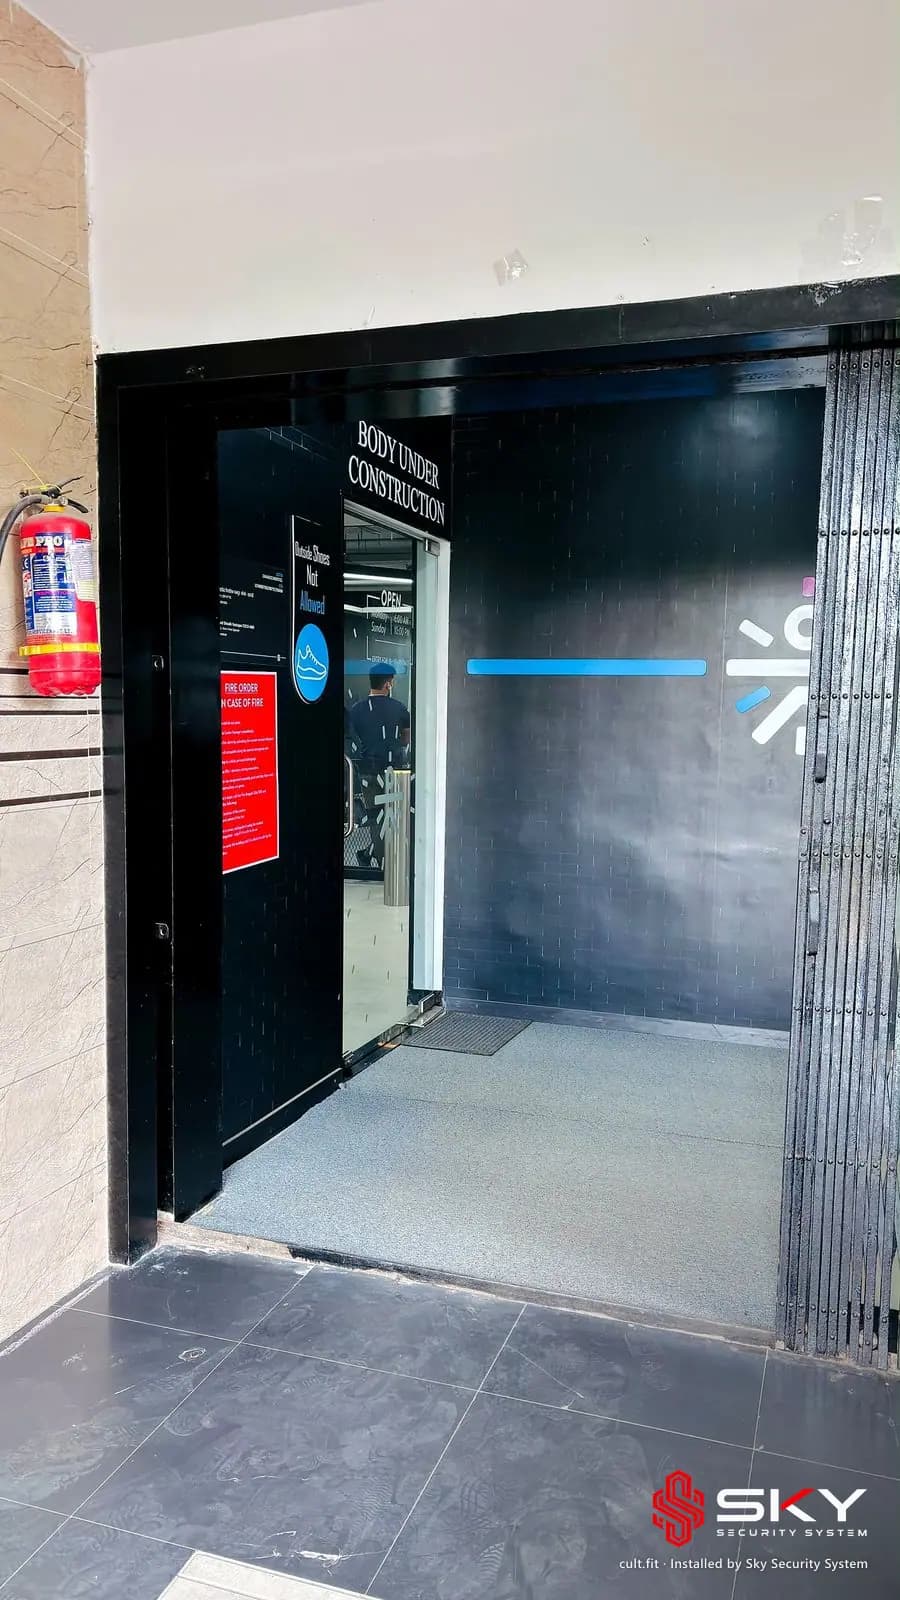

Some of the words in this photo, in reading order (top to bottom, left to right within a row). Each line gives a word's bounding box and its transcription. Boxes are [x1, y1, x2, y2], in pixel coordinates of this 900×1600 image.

[358, 420, 397, 464] BODY
[399, 442, 440, 490] UNDER
[348, 455, 445, 527] CONSTRUCTION
[313, 544, 331, 566] Shoes
[306, 563, 319, 588] Not
[300, 589, 325, 615] Allowed
[381, 590, 402, 608] OPEN
[224, 682, 238, 693] FIRE
[238, 682, 259, 693] ORDER
[226, 697, 242, 708] CASE
[242, 697, 251, 708] OF
[251, 697, 264, 708] FIRE
